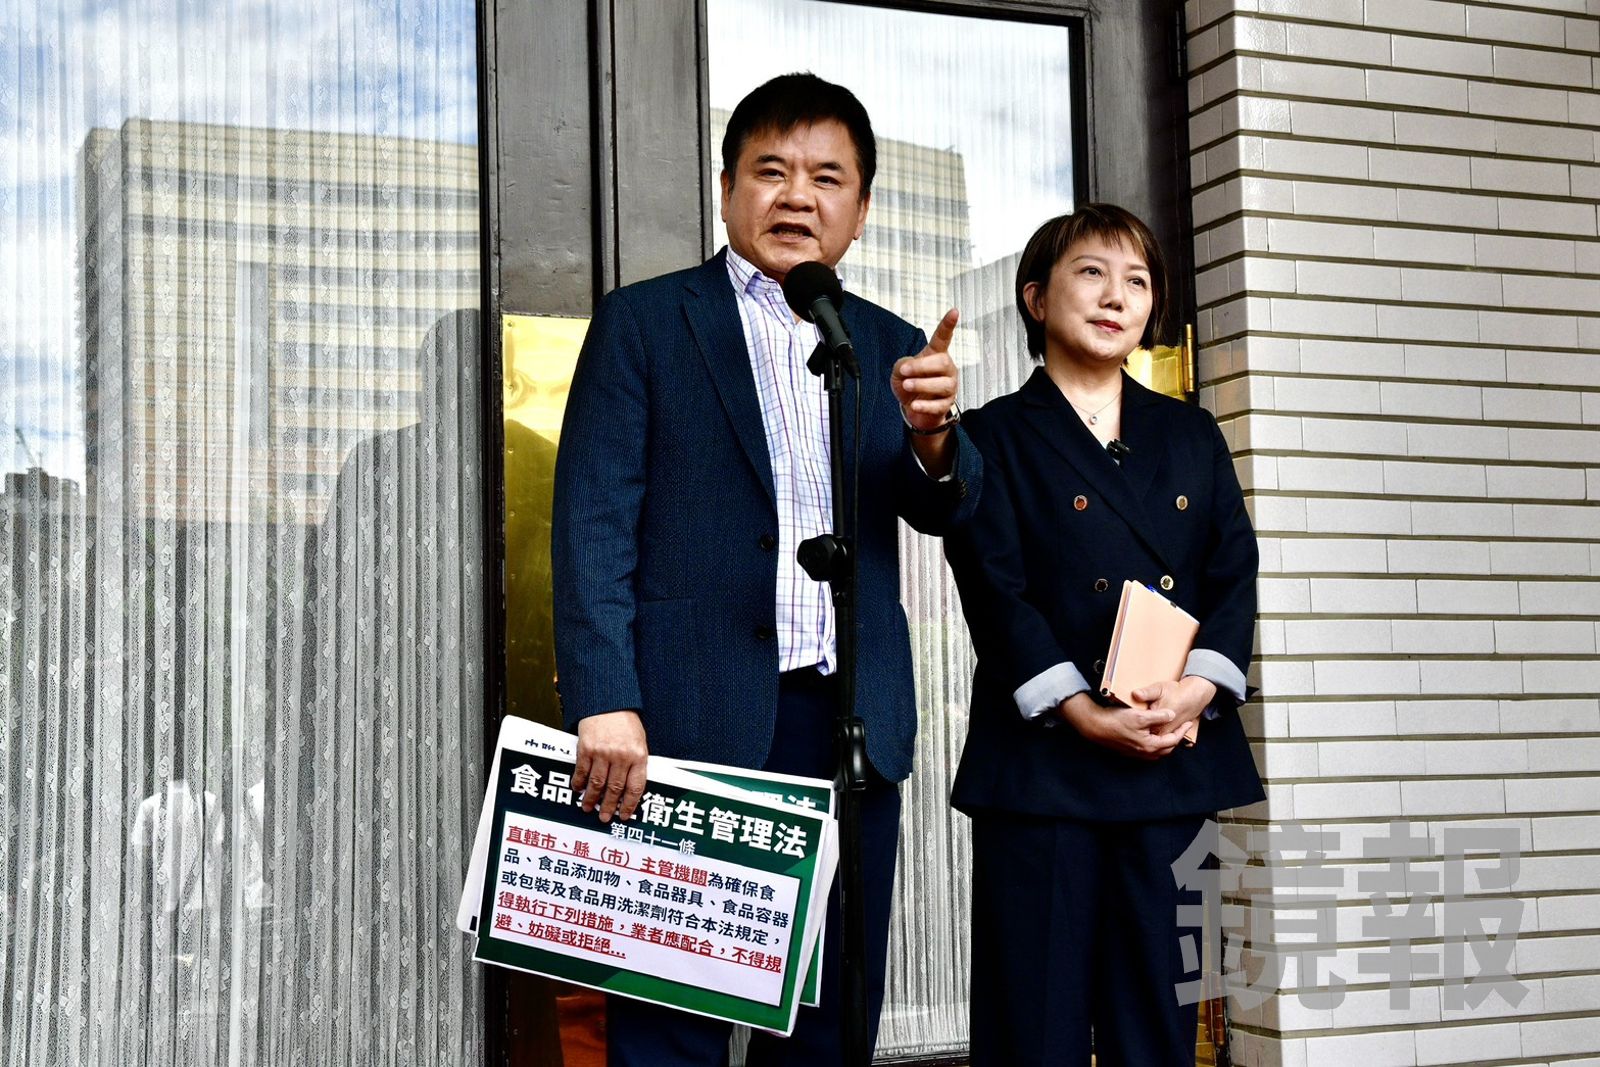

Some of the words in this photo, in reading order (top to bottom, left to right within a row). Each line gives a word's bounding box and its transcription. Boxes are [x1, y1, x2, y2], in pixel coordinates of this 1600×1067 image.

[510, 764, 808, 859] 食品衛生管理法
[610, 822, 696, 855] 第四十一條
[504, 847, 789, 928] 品、食品添加物、食品器具、食品容器
[506, 825, 776, 902] 直轄市、縣（市）主管機關為確保食
[498, 891, 782, 973] 得執行下列措施，業者應配合，不得規
[501, 870, 780, 946] 或包裝及食品用洗潔劑符合本法規定，
